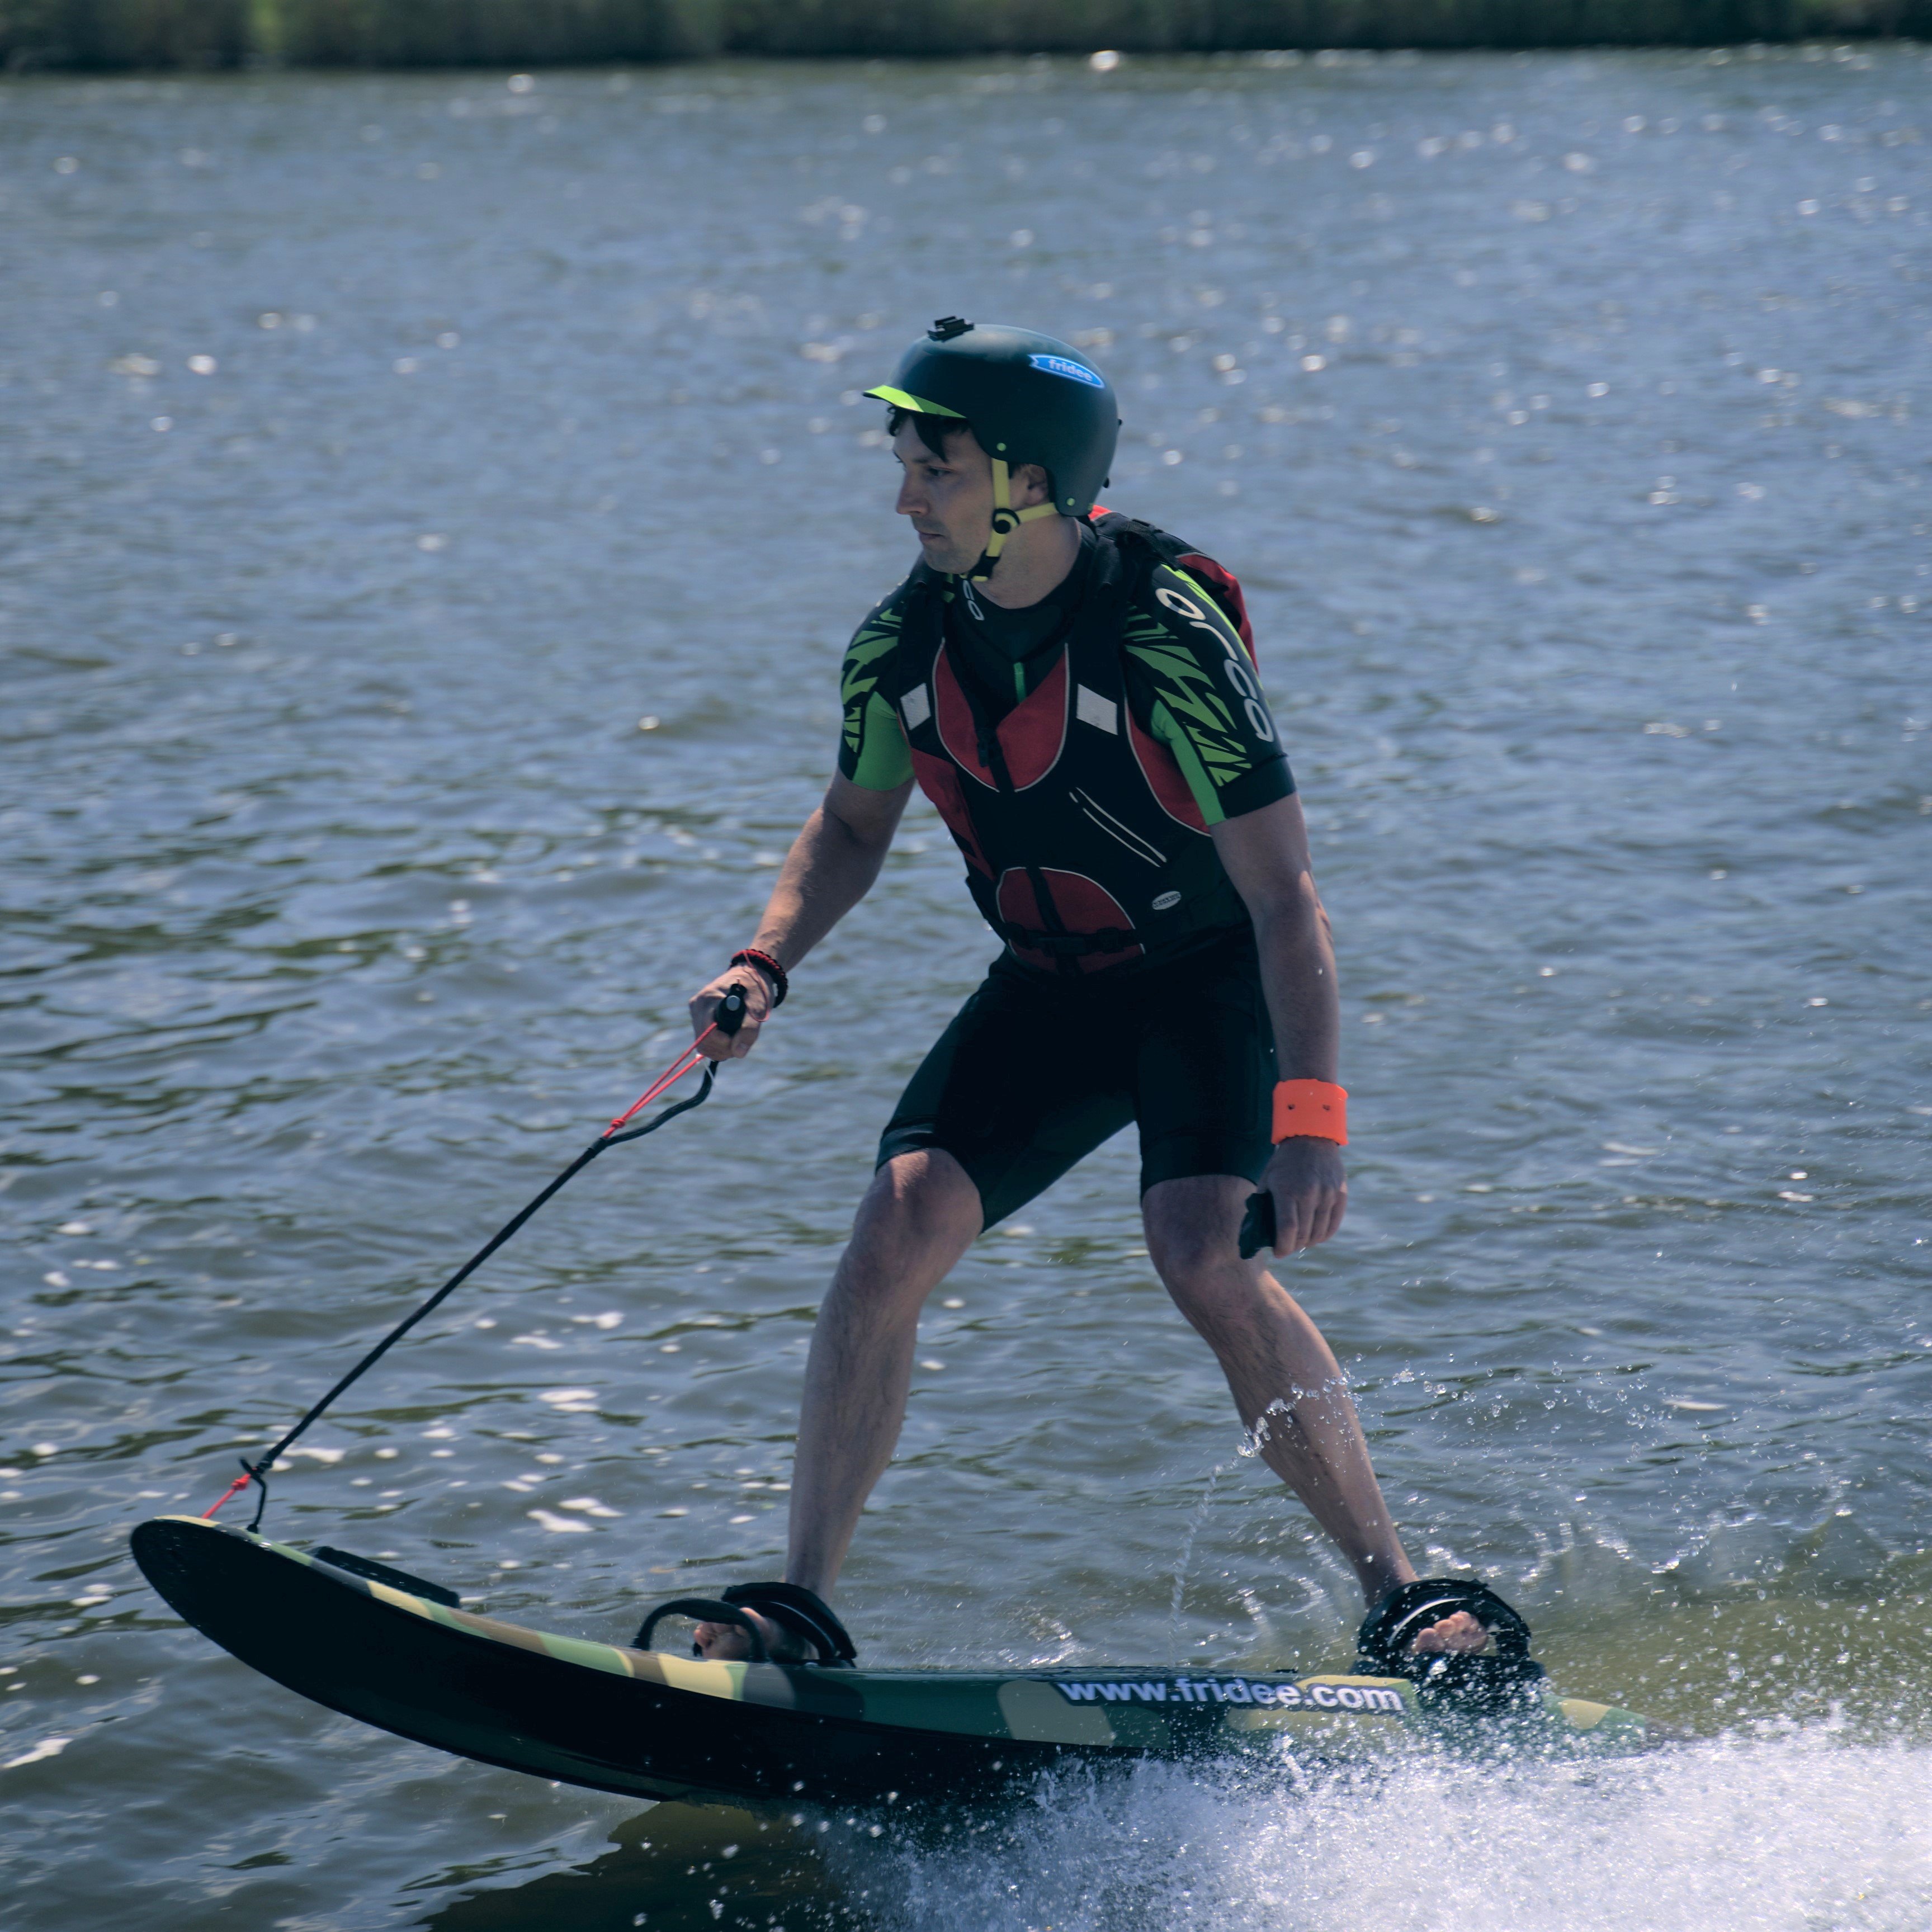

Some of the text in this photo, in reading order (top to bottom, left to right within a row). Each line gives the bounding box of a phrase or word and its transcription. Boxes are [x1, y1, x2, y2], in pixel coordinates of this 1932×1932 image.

[1048, 358, 1093, 381] fridee
[1155, 588, 1275, 743] orca
[1057, 1678, 1405, 1711] www.fridee.com
